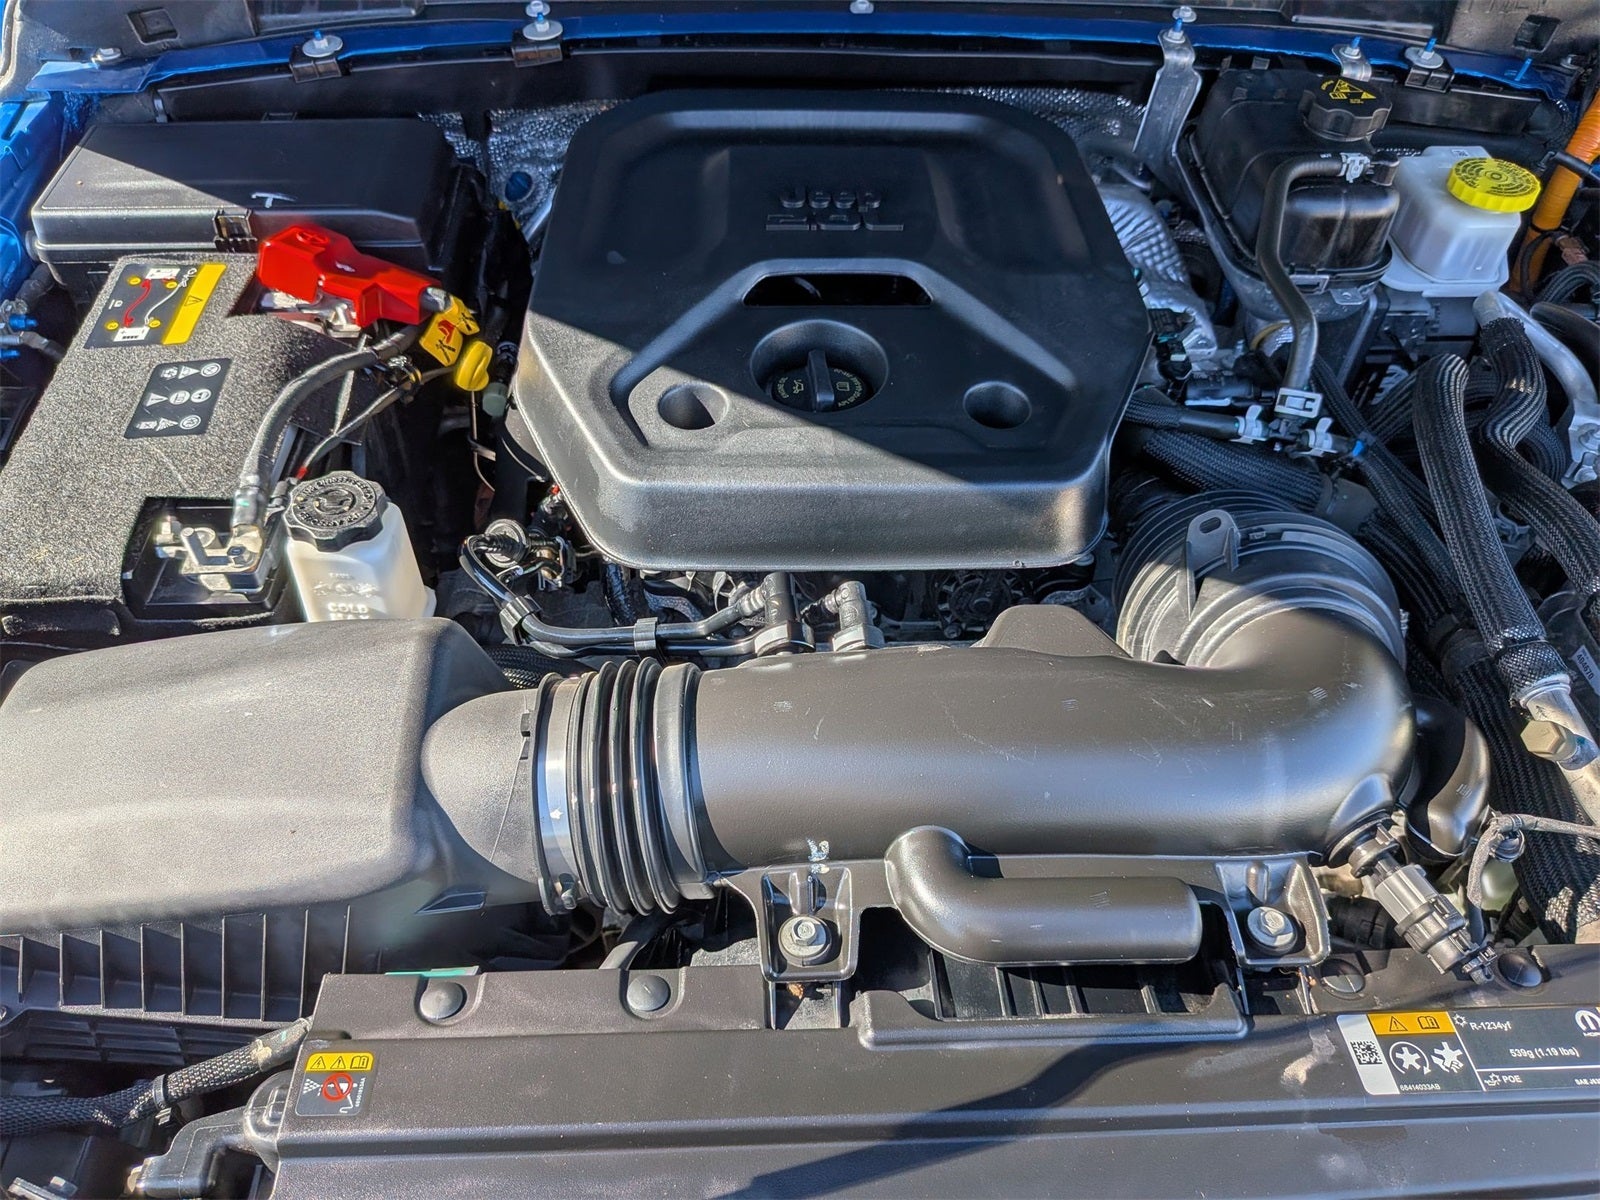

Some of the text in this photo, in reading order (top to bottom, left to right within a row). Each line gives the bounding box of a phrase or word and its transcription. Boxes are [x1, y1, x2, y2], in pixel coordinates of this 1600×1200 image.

[780, 185, 881, 212] Jeep
[327, 602, 369, 614] COLD
[1469, 1021, 1512, 1032] R-1234yf
[1509, 1048, 1535, 1059] 539g
[1559, 1046, 1580, 1058] lbs)
[1501, 1075, 1522, 1084] POE
